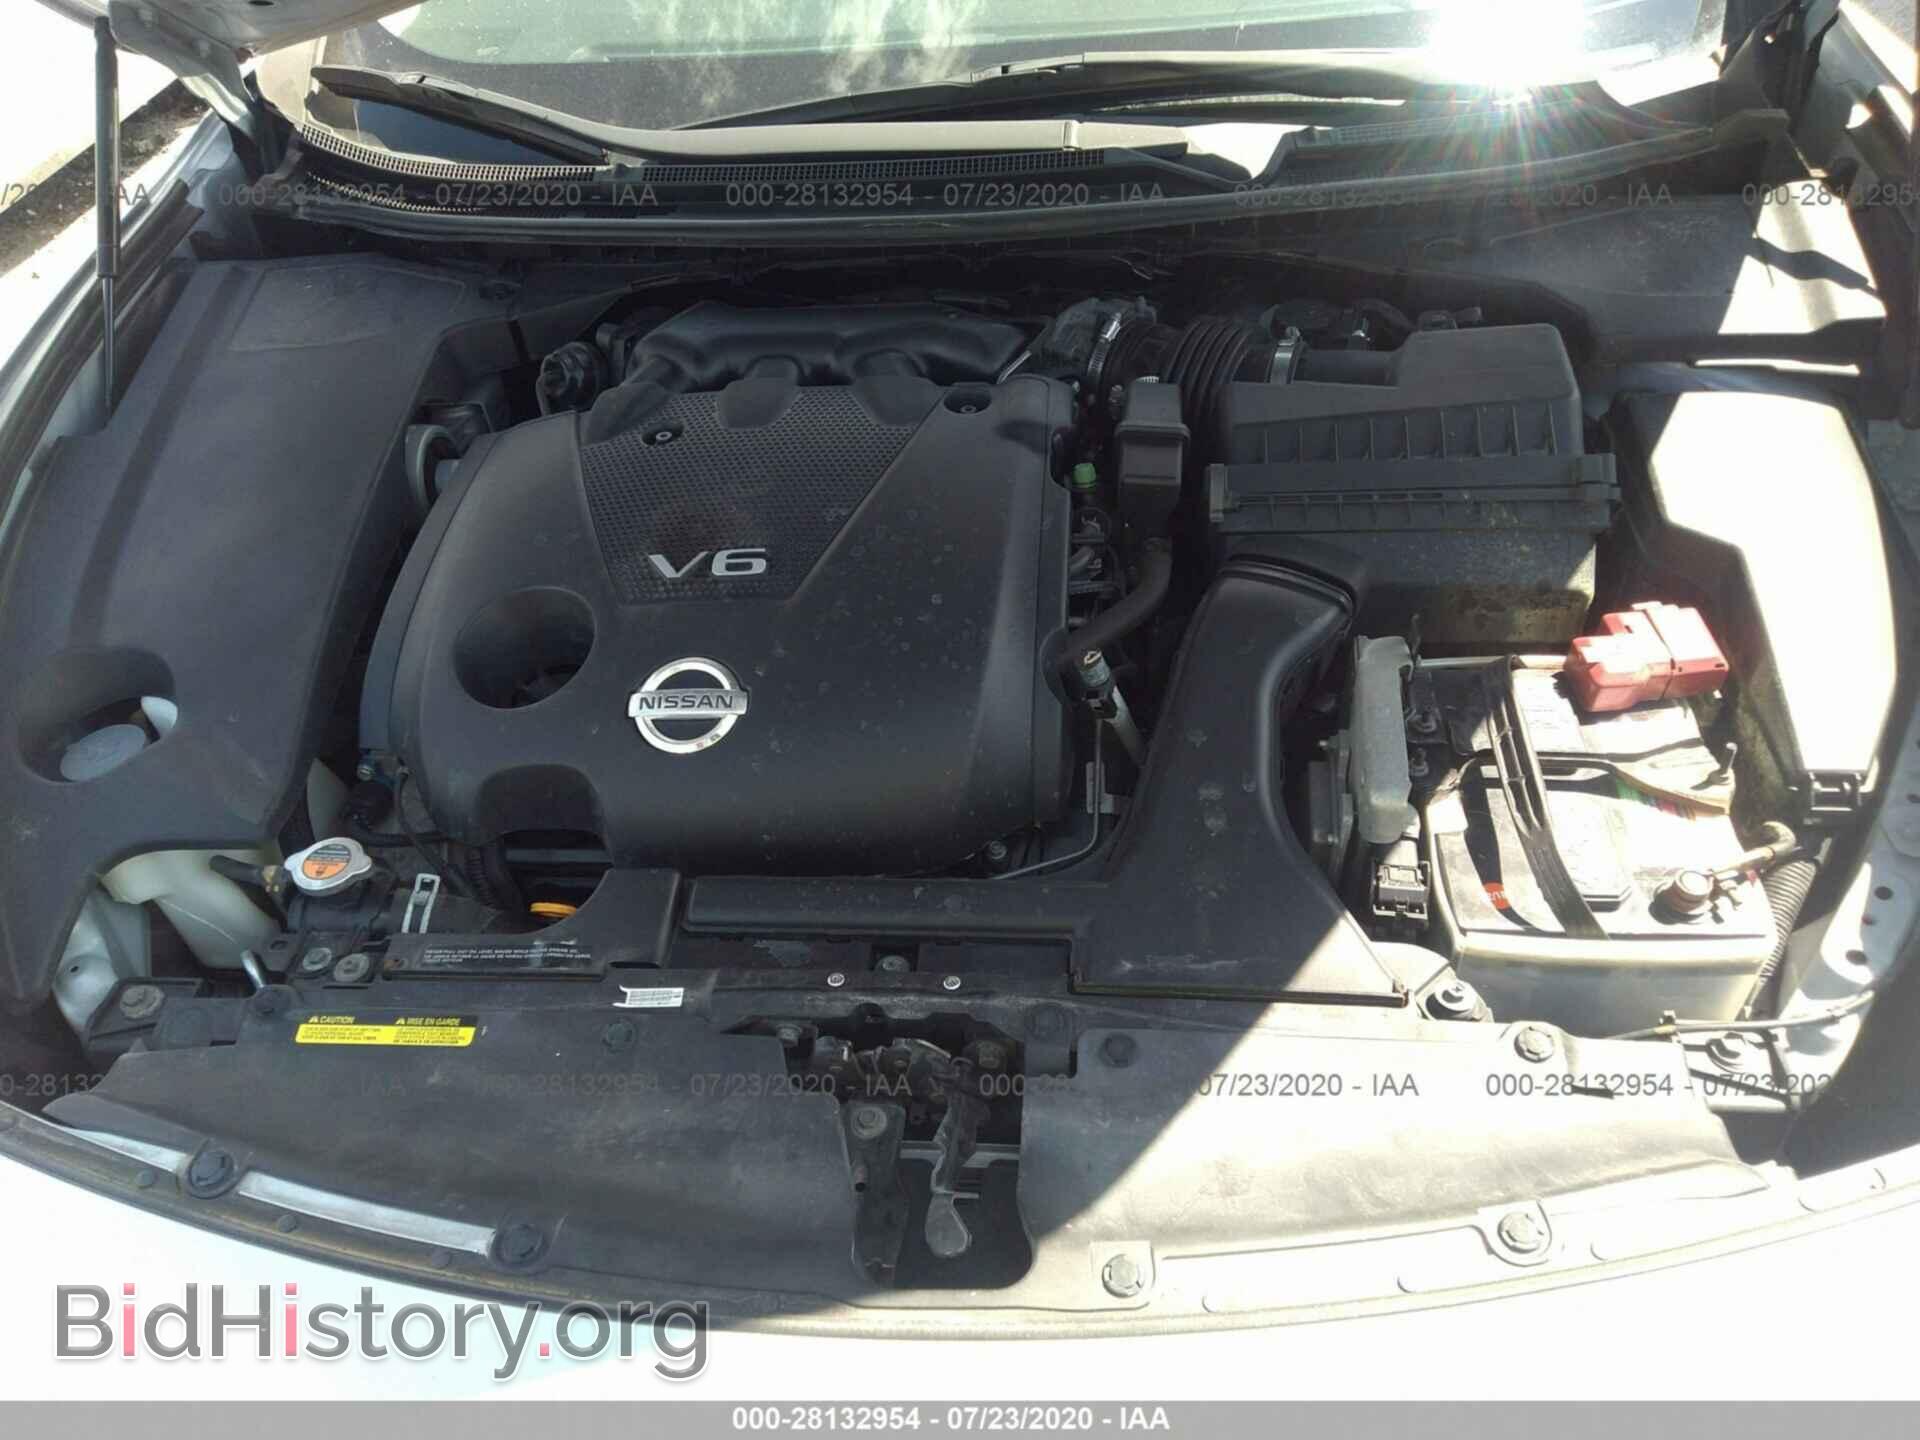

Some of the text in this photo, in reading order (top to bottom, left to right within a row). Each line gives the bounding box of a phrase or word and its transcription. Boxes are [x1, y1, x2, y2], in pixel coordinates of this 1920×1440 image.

[649, 548, 767, 579] V6
[639, 695, 733, 710] NISSAN
[319, 1016, 355, 1025] CAUTION
